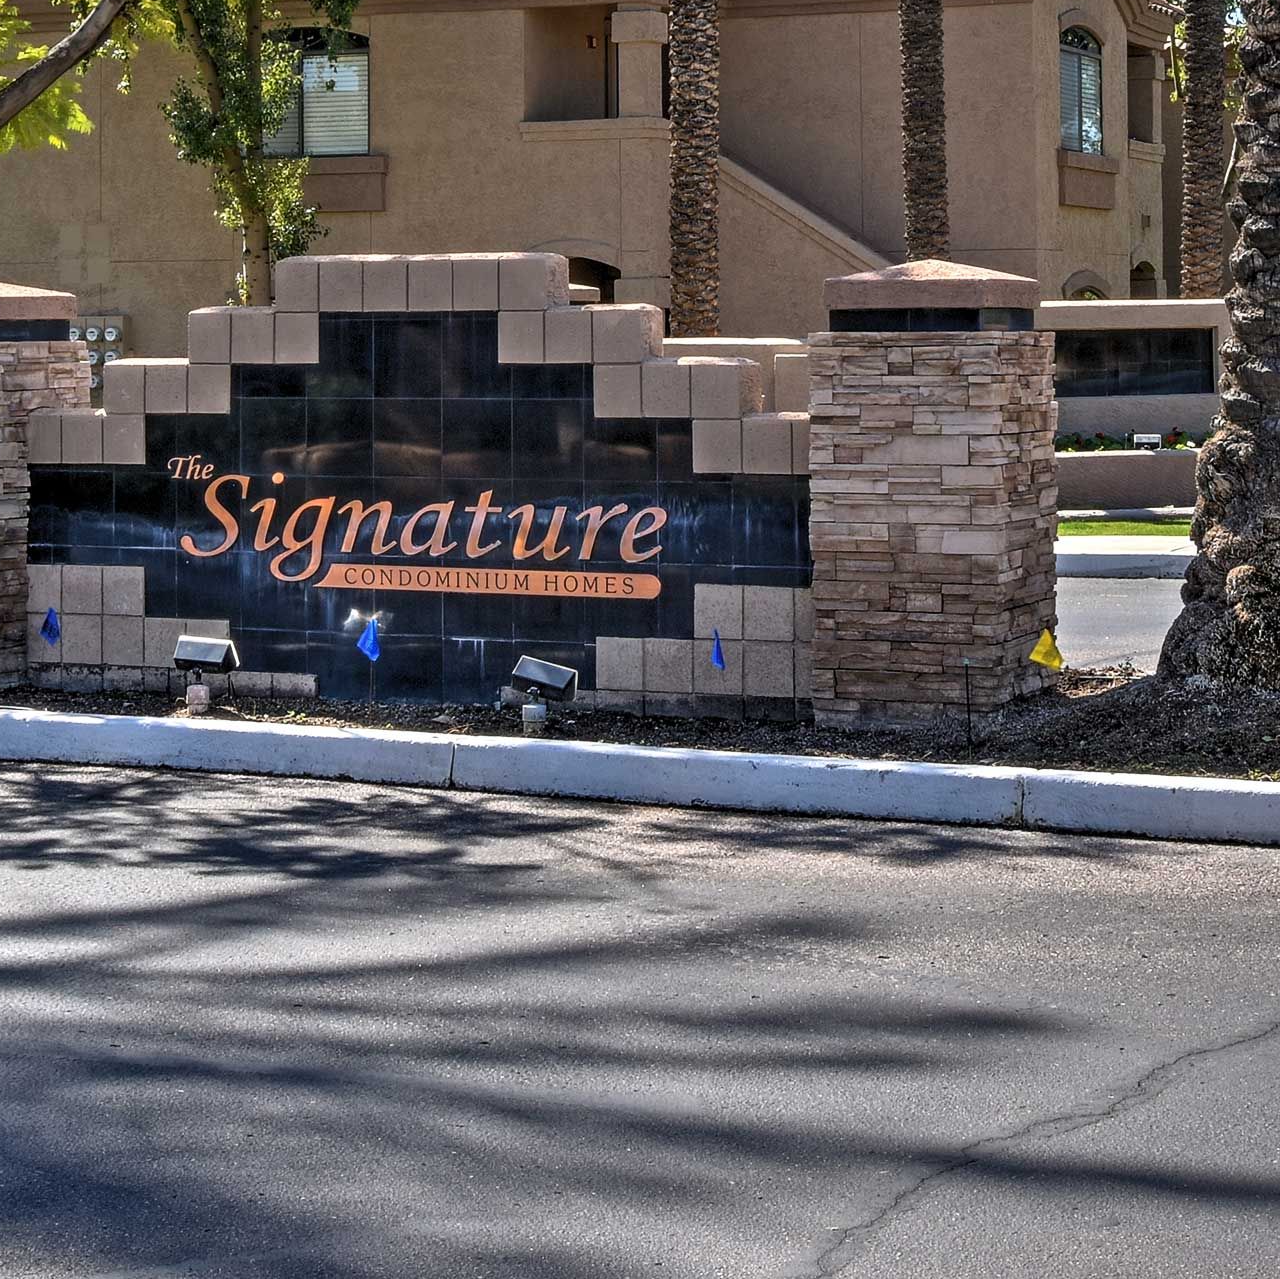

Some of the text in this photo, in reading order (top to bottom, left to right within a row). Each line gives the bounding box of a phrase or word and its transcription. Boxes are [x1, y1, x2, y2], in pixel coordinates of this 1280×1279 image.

[167, 454, 215, 480] The
[180, 472, 669, 581] Signature
[344, 567, 635, 595] CONDOMINIUM HOMES
